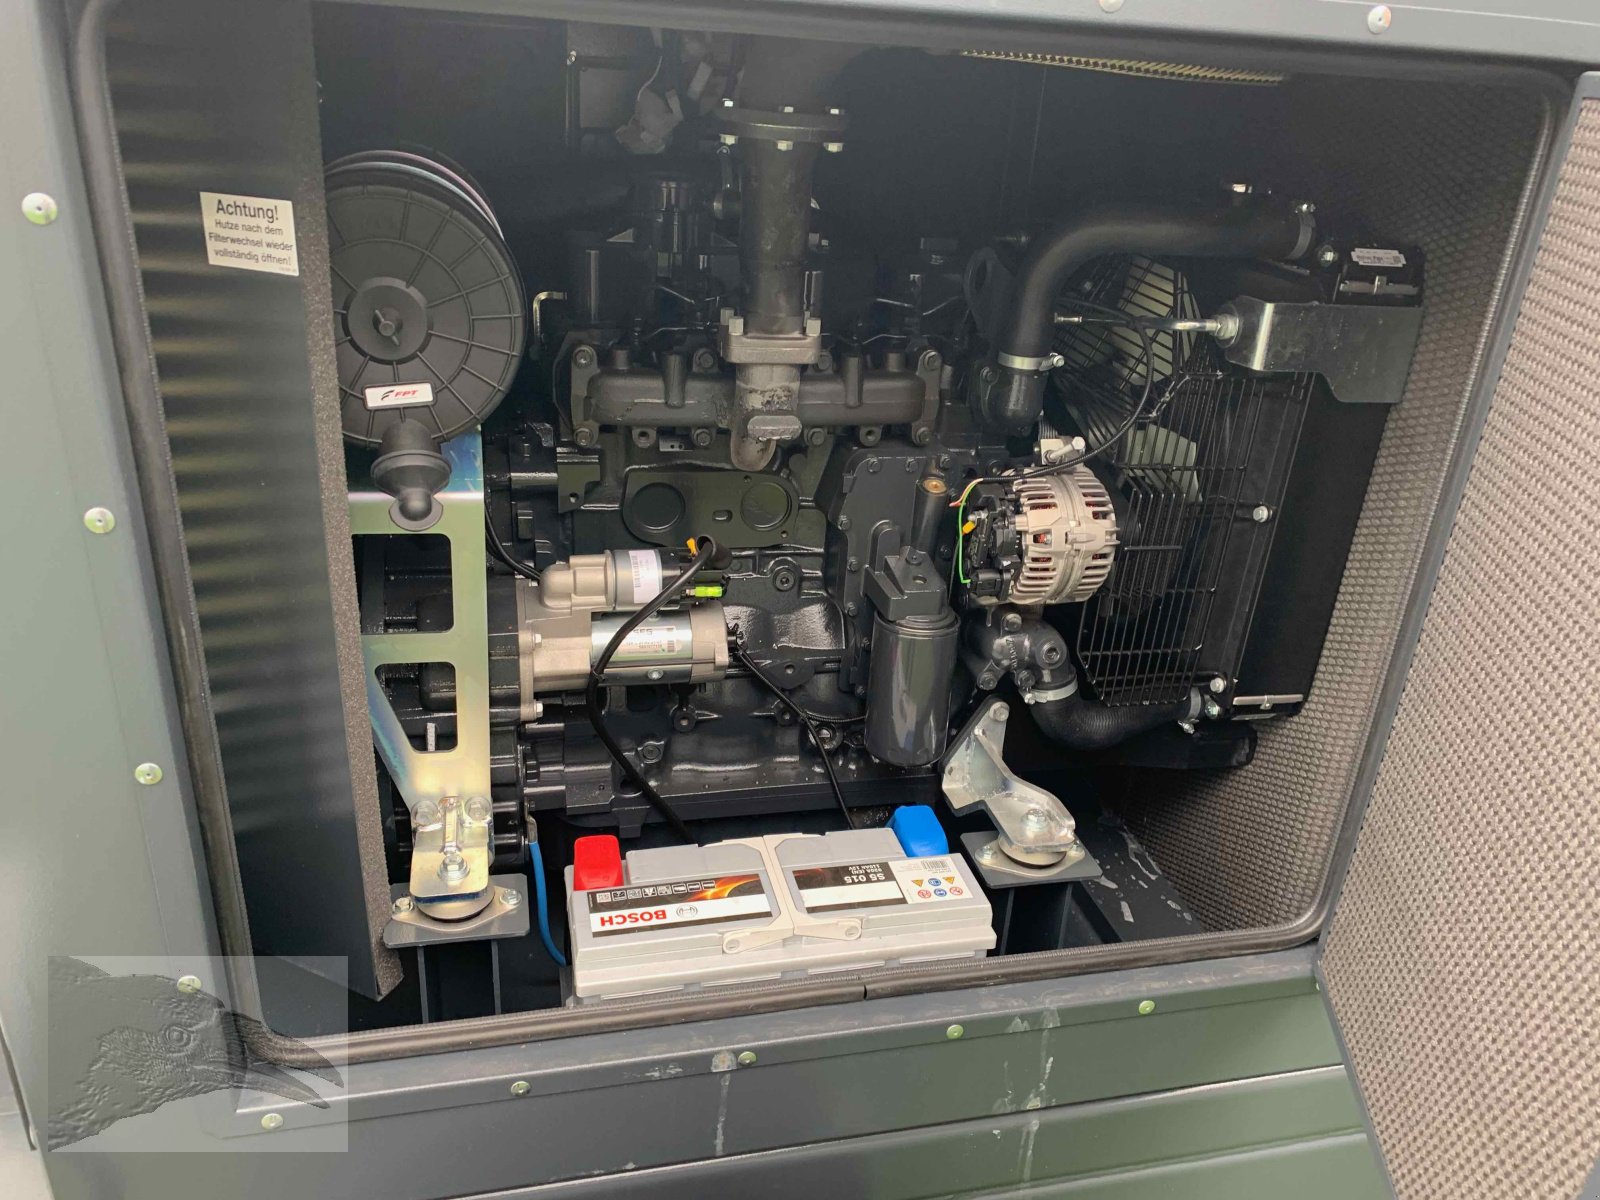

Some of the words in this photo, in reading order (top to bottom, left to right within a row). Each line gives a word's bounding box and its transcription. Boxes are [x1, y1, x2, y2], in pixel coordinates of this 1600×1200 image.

[216, 199, 279, 223] Achtung!
[215, 219, 239, 231] Hutze
[241, 223, 262, 233] nach
[265, 225, 284, 236] dem
[208, 232, 263, 248] Filterwechsel
[265, 240, 293, 251] wieder
[214, 248, 259, 263] vollständig
[261, 254, 292, 266] öffnen!
[394, 389, 418, 398] FPT
[843, 874, 867, 884] 015
[869, 873, 885, 881] S5
[600, 909, 667, 927] BOSCH
